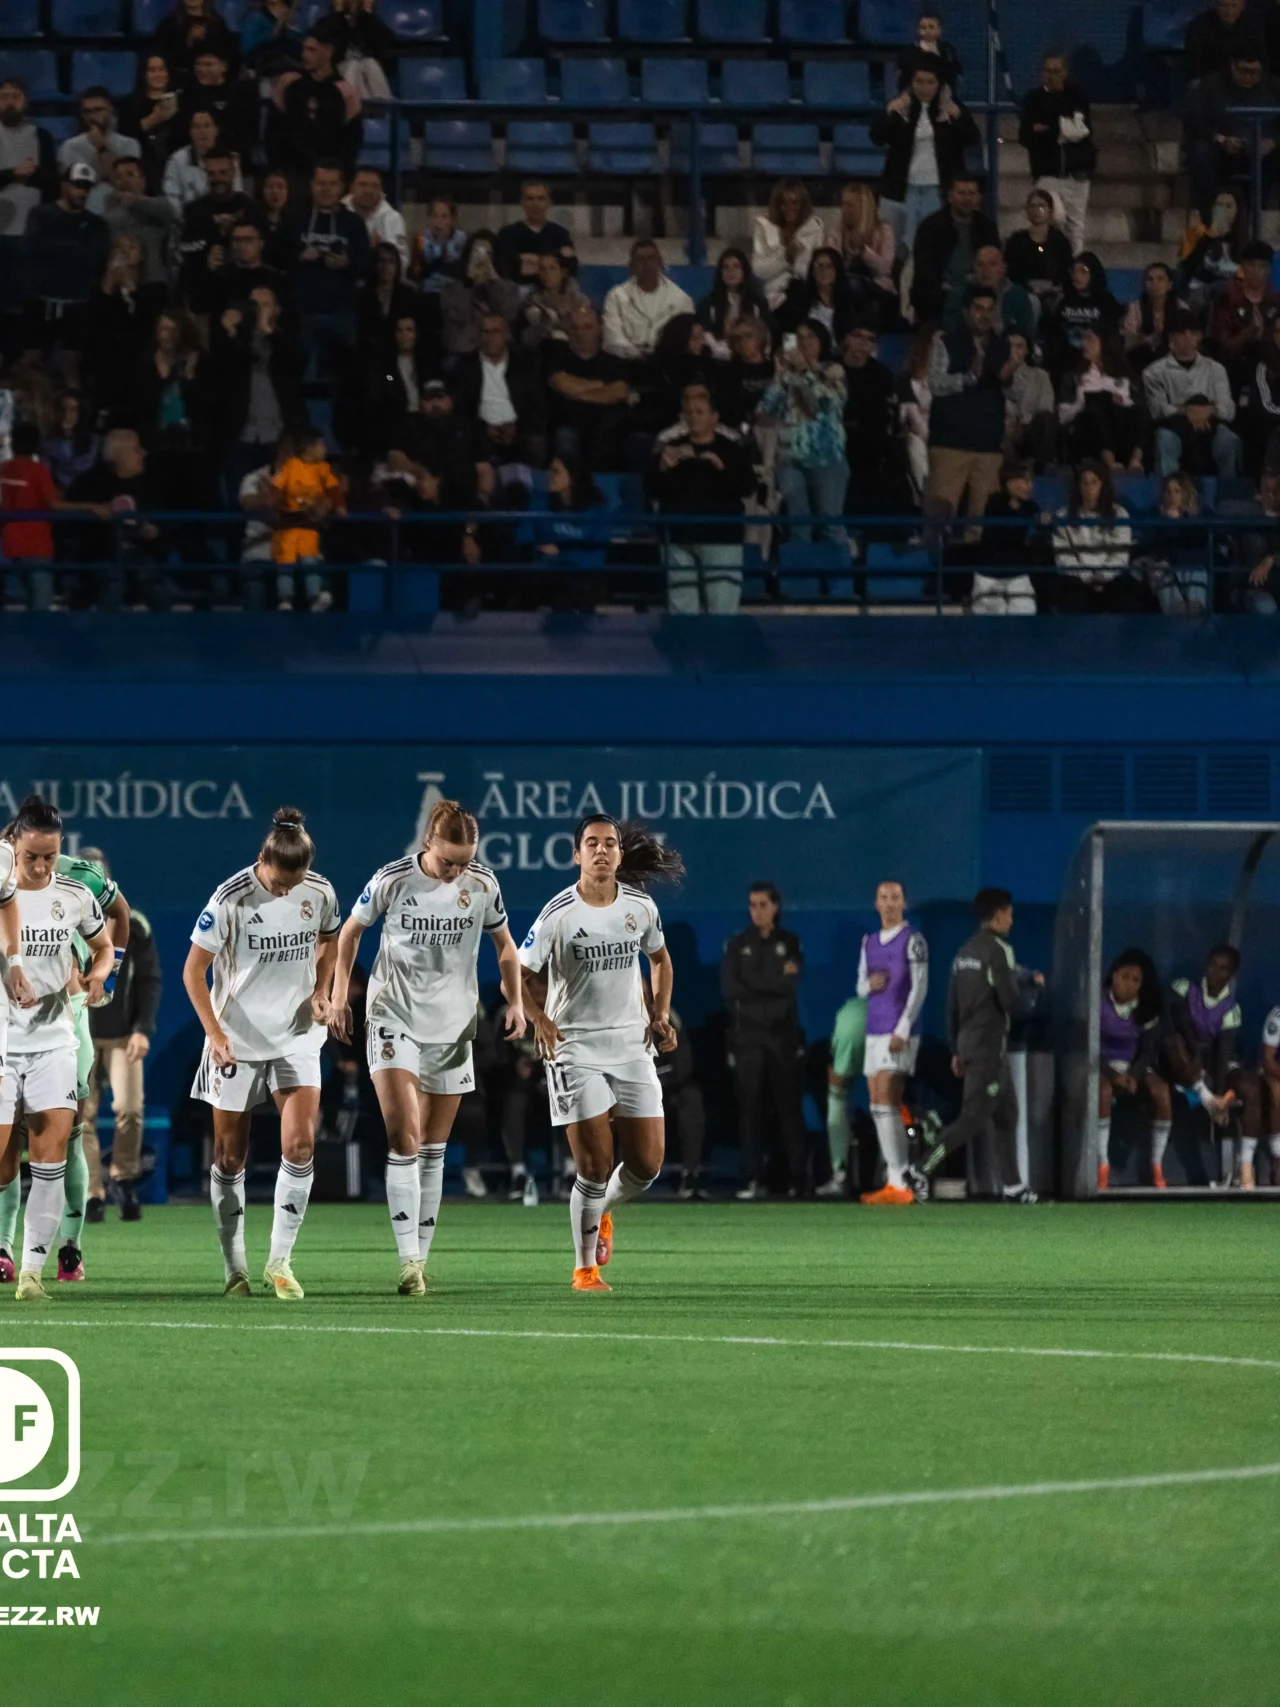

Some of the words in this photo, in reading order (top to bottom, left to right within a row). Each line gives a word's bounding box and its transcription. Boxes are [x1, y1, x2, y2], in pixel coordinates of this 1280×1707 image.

[617, 770, 837, 823] JURÍDICA
[401, 913, 474, 931] Emirates
[247, 929, 317, 950] Emirates
[411, 933, 427, 946] FLY
[429, 932, 463, 946] BETTER
[25, 944, 61, 957] BETTER
[259, 952, 274, 964] FLY
[278, 946, 309, 962] BETTER
[572, 938, 640, 960] Emirates
[585, 960, 600, 973] FLY
[601, 955, 634, 972] BETTER
